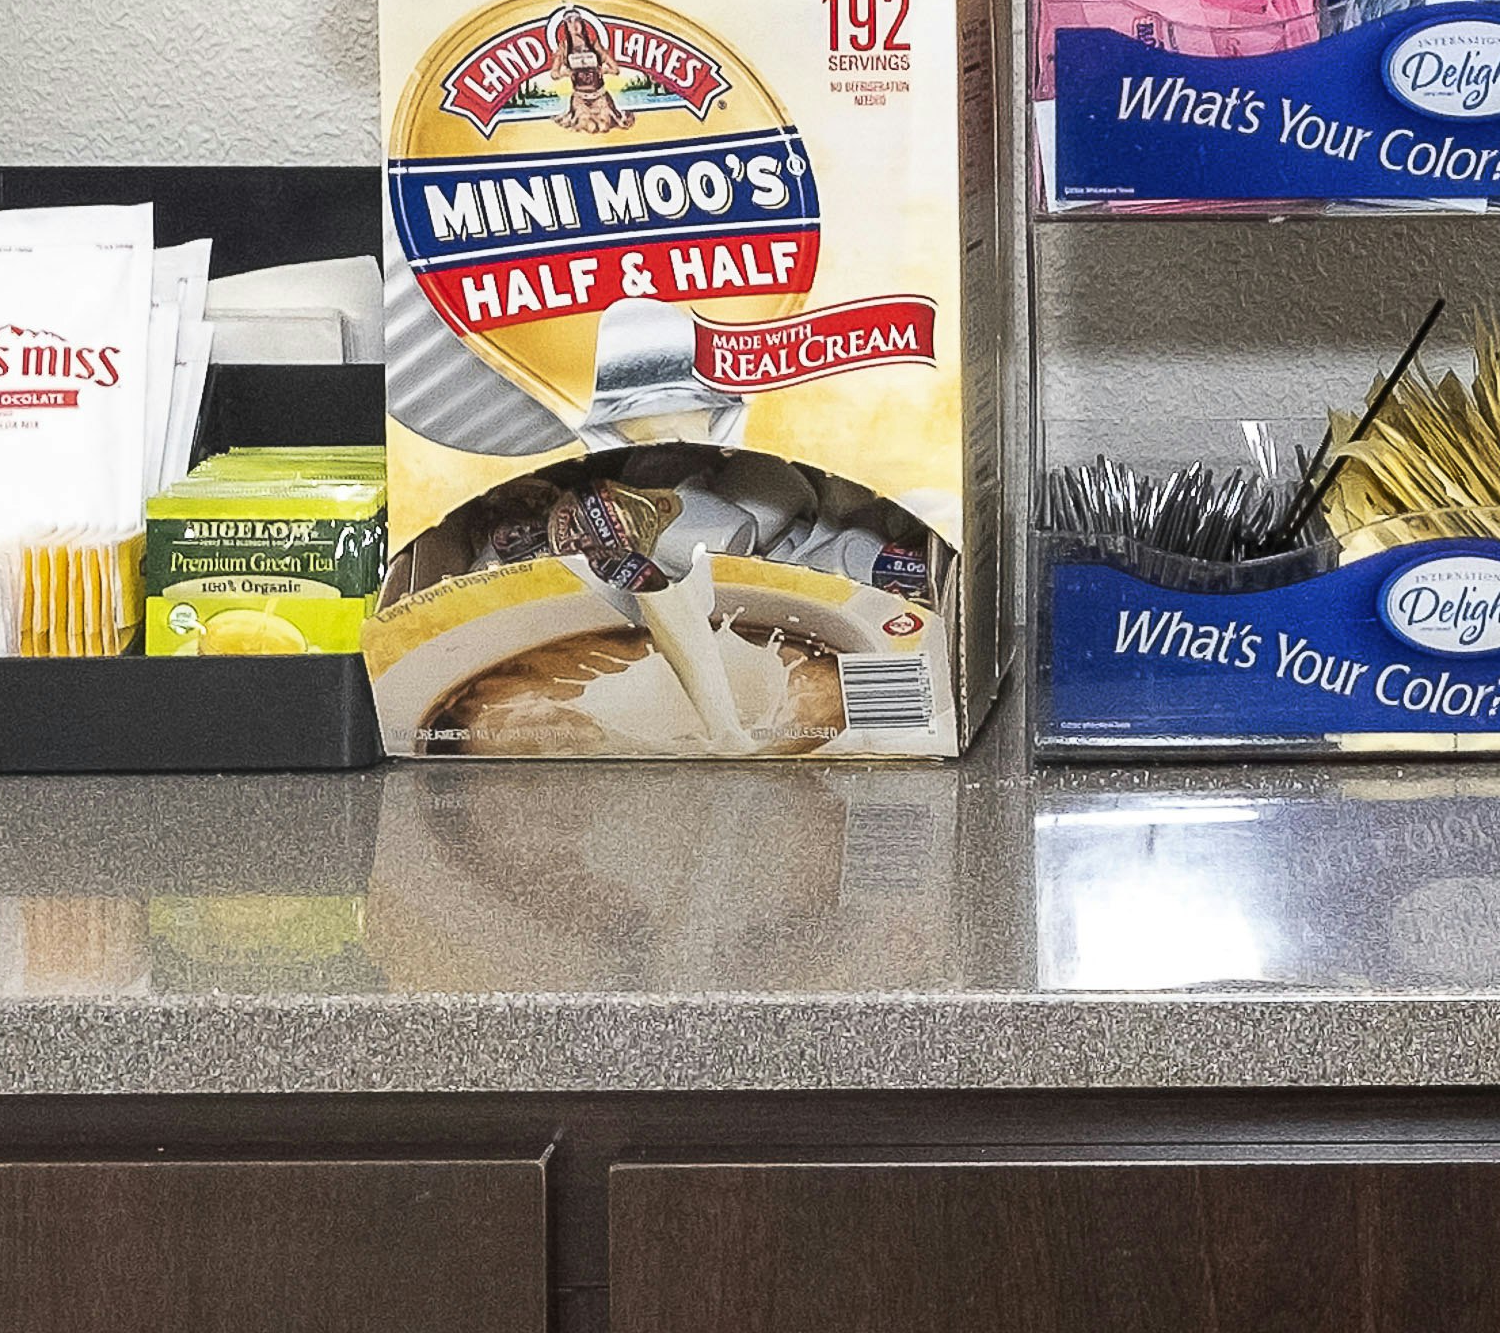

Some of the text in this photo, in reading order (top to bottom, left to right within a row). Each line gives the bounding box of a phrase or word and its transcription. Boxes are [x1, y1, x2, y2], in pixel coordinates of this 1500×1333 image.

[463, 35, 547, 104] LAND
[613, 28, 702, 89] LAKES
[828, 54, 911, 71] SERVINGS
[1117, 75, 1266, 134] What's
[1278, 99, 1373, 164] Your
[423, 152, 790, 242] MINI MOO'S
[461, 240, 799, 323] HALF & HALF
[712, 323, 812, 350] MADE WITH
[713, 322, 918, 382] REAL CREAM
[170, 551, 335, 572] Premium Green Tea
[241, 580, 301, 595] Organic
[453, 563, 534, 589] Dispenser
[1114, 609, 1262, 669] What's
[1276, 633, 1370, 698] Your
